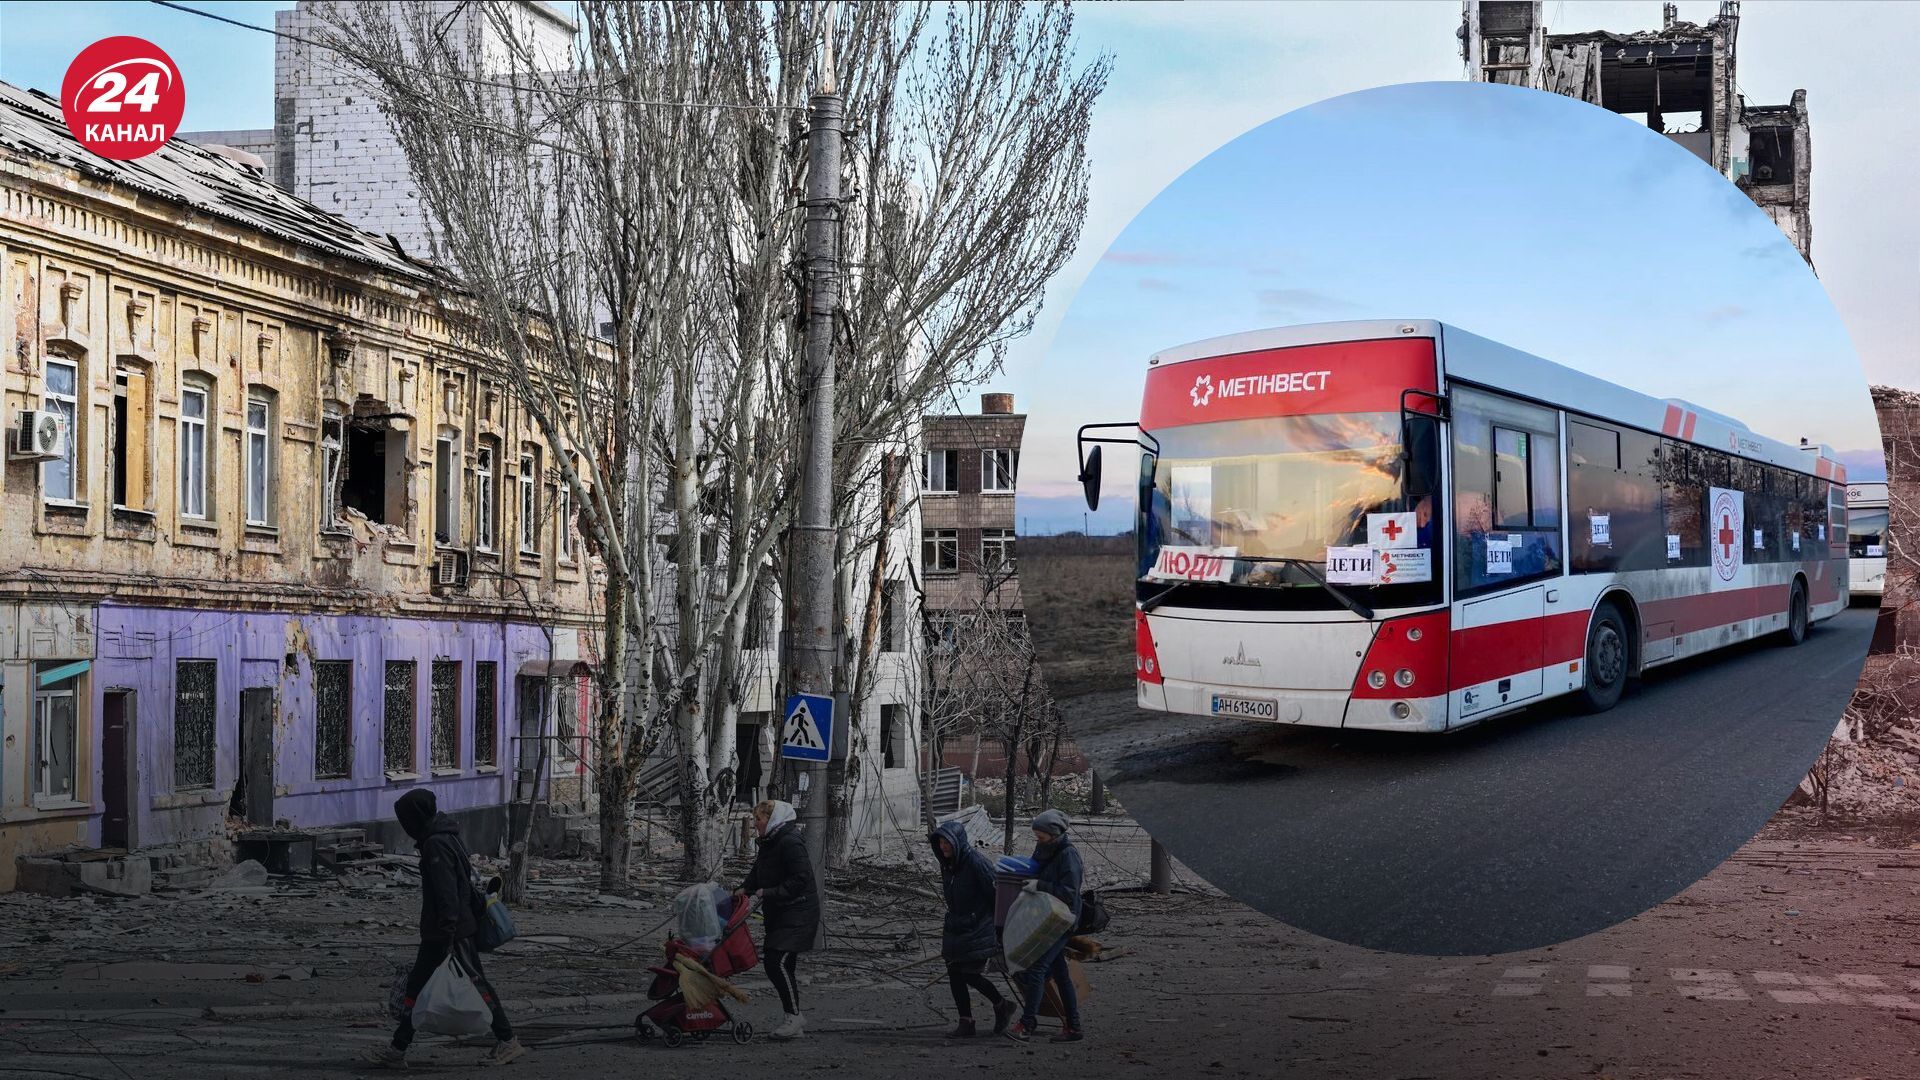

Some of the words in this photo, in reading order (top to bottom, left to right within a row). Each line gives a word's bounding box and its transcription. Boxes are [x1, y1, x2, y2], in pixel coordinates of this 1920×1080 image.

[1218, 371, 1331, 398] МЕТІНВЕСТ
[1158, 550, 1223, 581] ЛЮДИ
[1327, 558, 1372, 573] ДЕТИ
[1487, 550, 1513, 563] ДЕТИ
